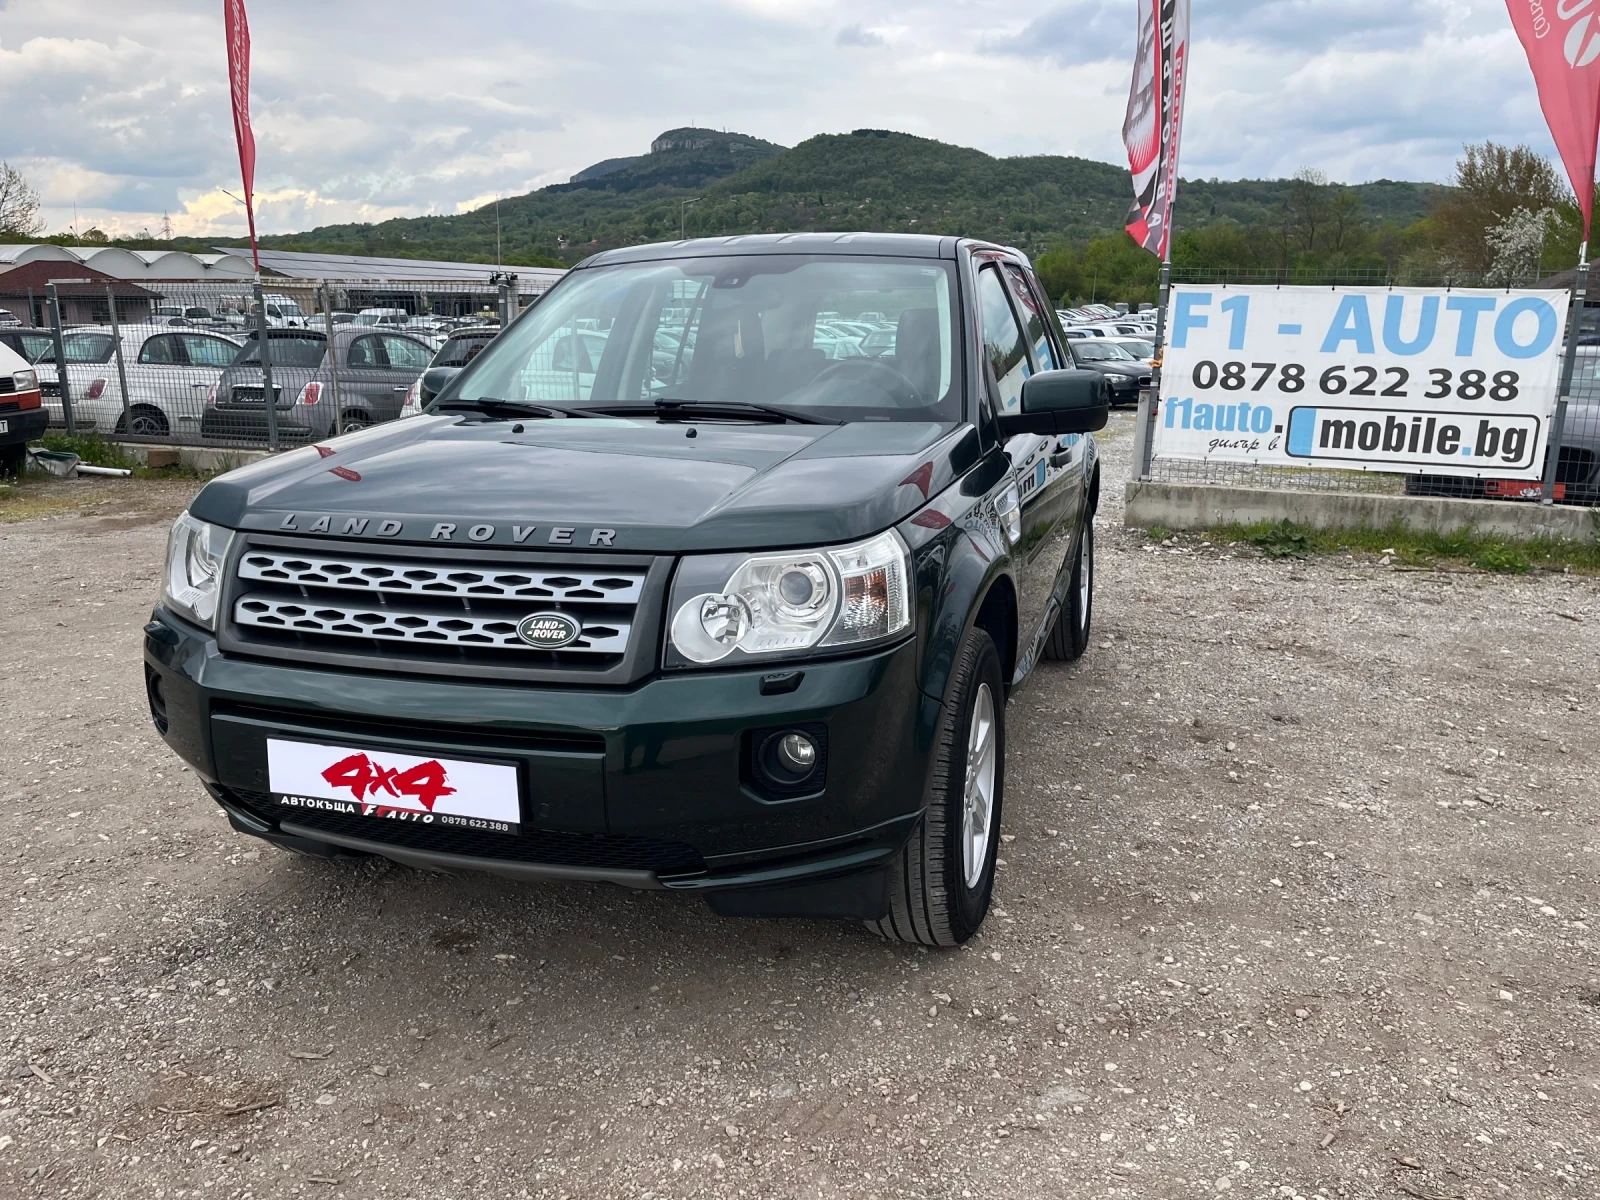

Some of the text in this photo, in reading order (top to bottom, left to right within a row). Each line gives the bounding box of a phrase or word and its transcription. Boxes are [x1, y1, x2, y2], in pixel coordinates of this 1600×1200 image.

[1170, 292, 1250, 350] F1
[1320, 294, 1558, 359] AUTO
[1192, 360, 1520, 401] 0878 622 388
[1320, 414, 1528, 462] mobile.bg
[279, 514, 617, 547] LAND ROVER
[532, 629, 567, 639] ROVER
[281, 796, 355, 813] АВТОКЪЩА
[387, 810, 434, 823] AUTO
[441, 815, 467, 826] 0878
[469, 819, 487, 829] 622
[489, 821, 509, 832] 388
